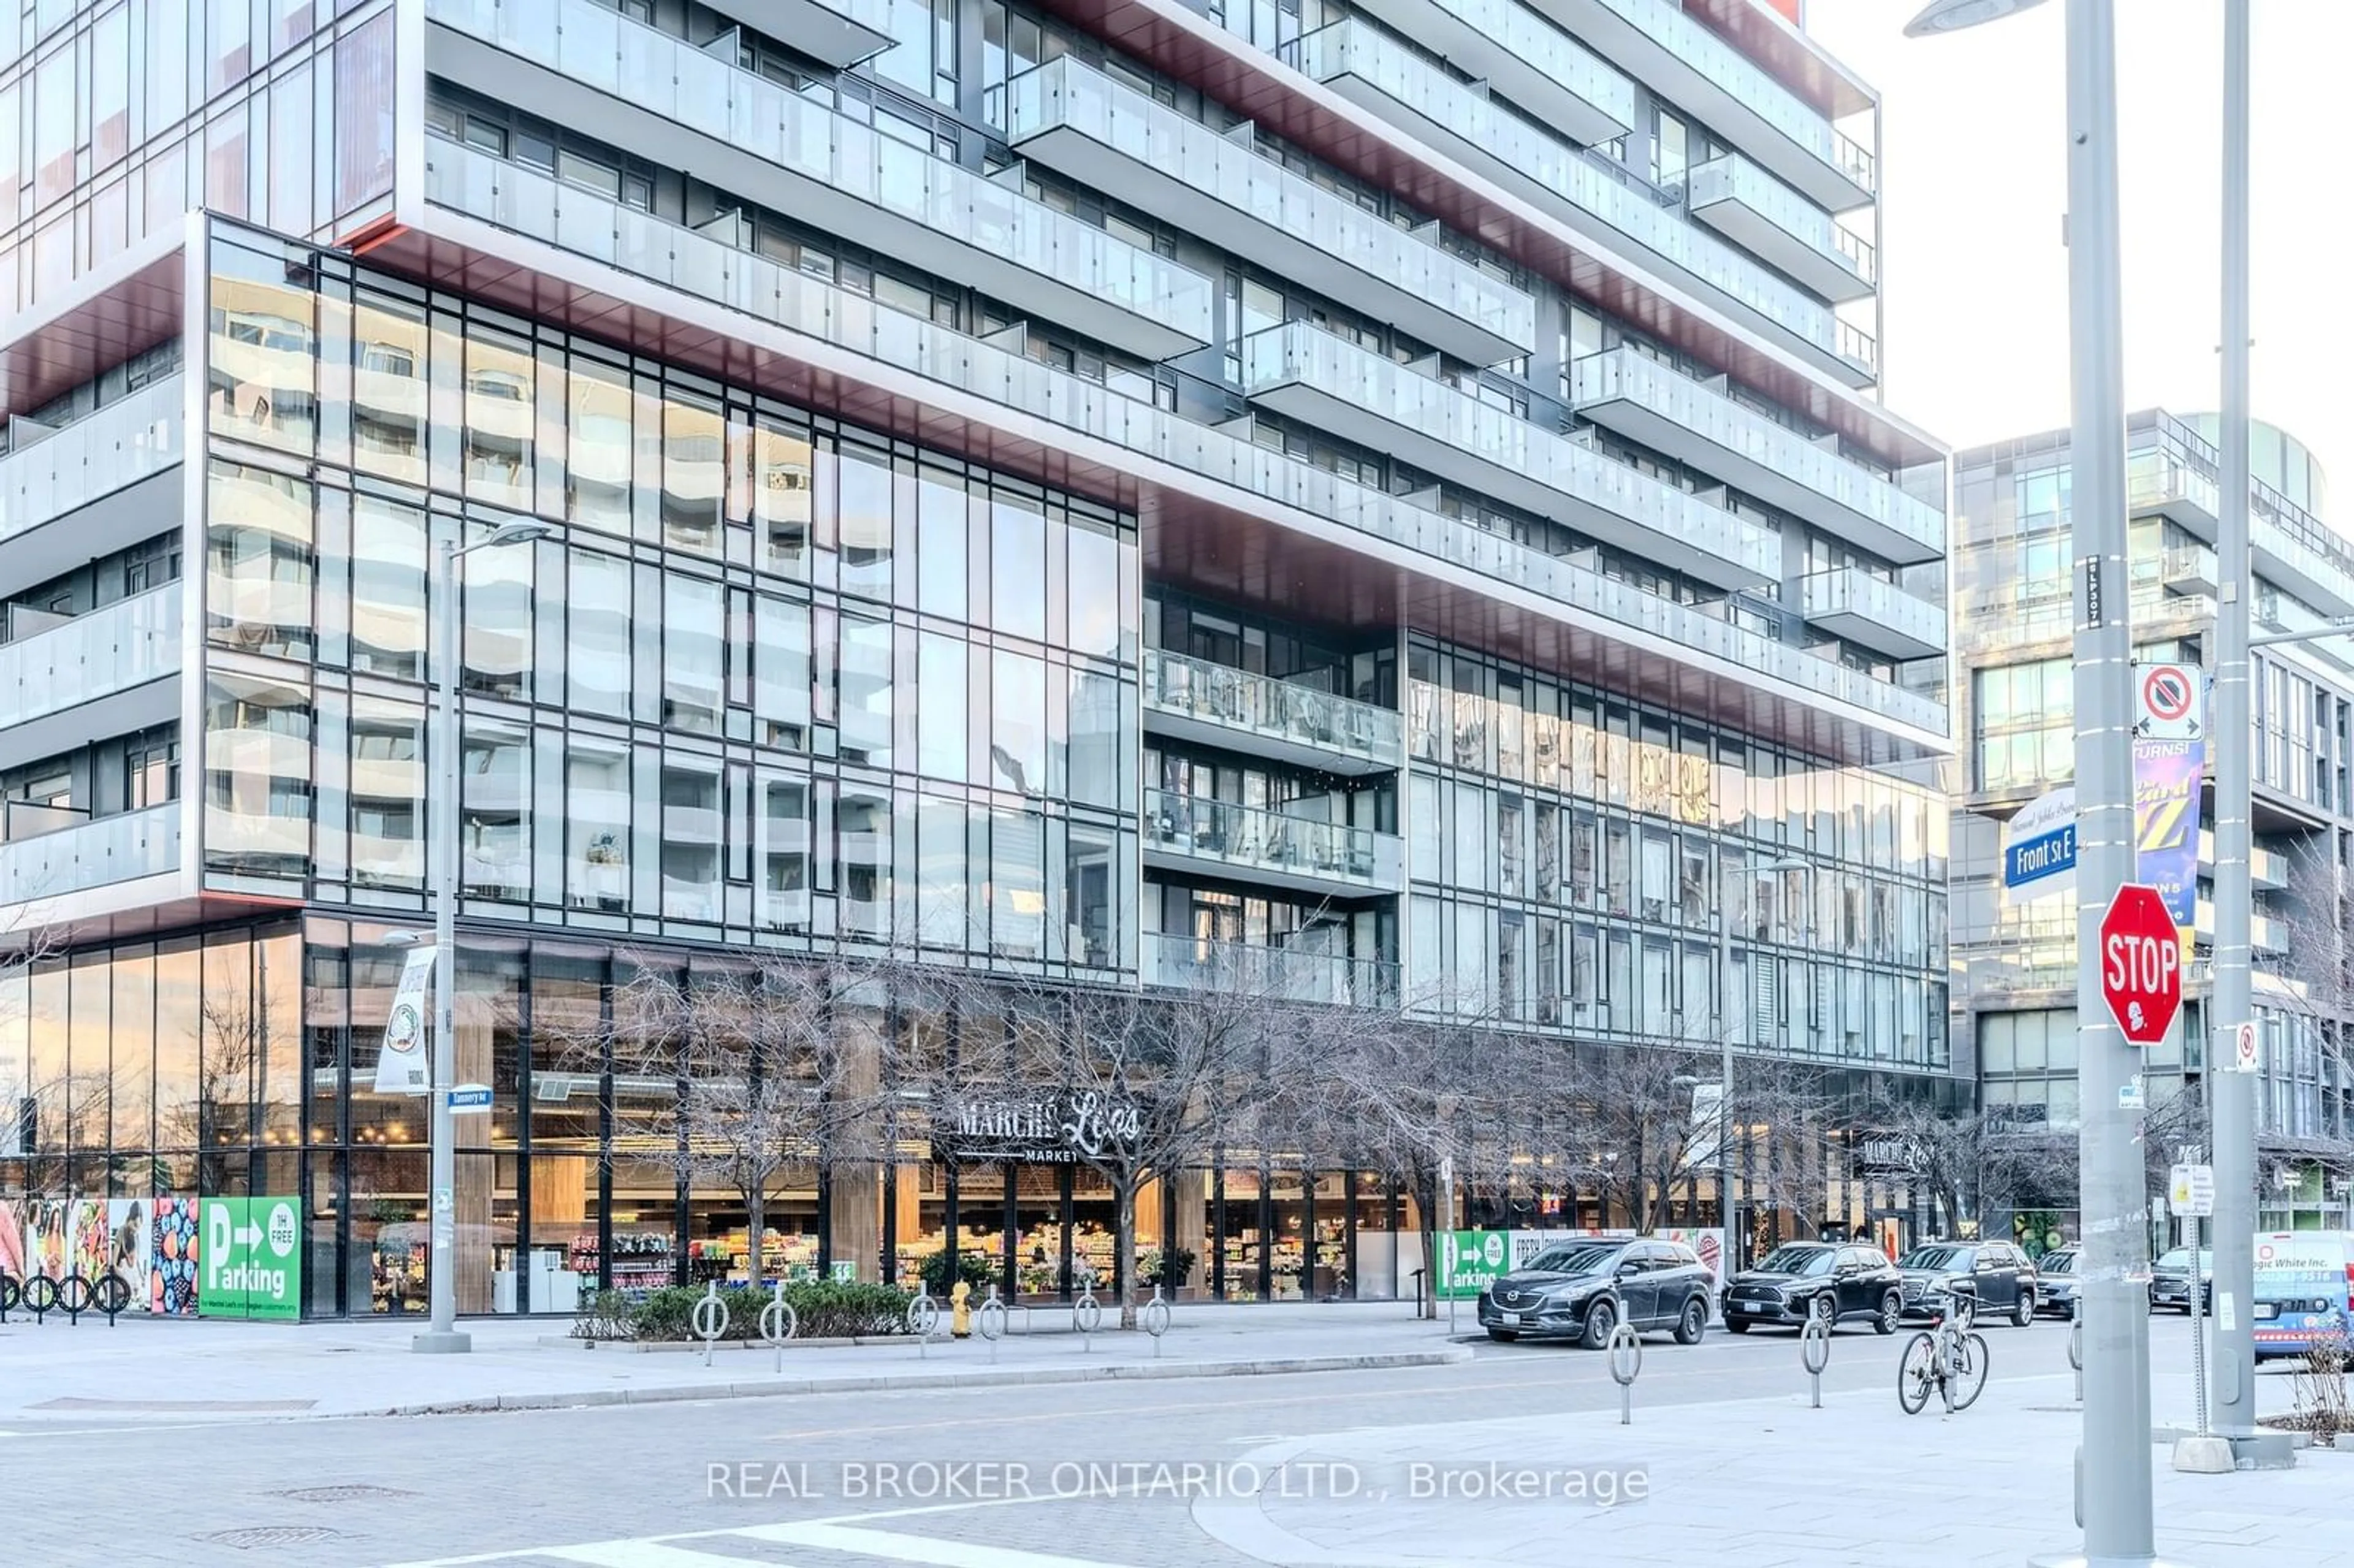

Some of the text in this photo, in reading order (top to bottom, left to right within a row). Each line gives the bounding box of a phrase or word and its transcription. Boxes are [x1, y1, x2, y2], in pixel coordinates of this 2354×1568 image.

[2017, 839, 2049, 875] Front
[2063, 829, 2071, 859] E
[2107, 933, 2177, 994] STOP
[1026, 1150, 1077, 1162] MARKET
[208, 1203, 286, 1300] Parking
[272, 1230, 293, 1244] FREE
[2275, 1258, 2307, 1268] White
[2308, 1258, 2328, 1268] Inc.
